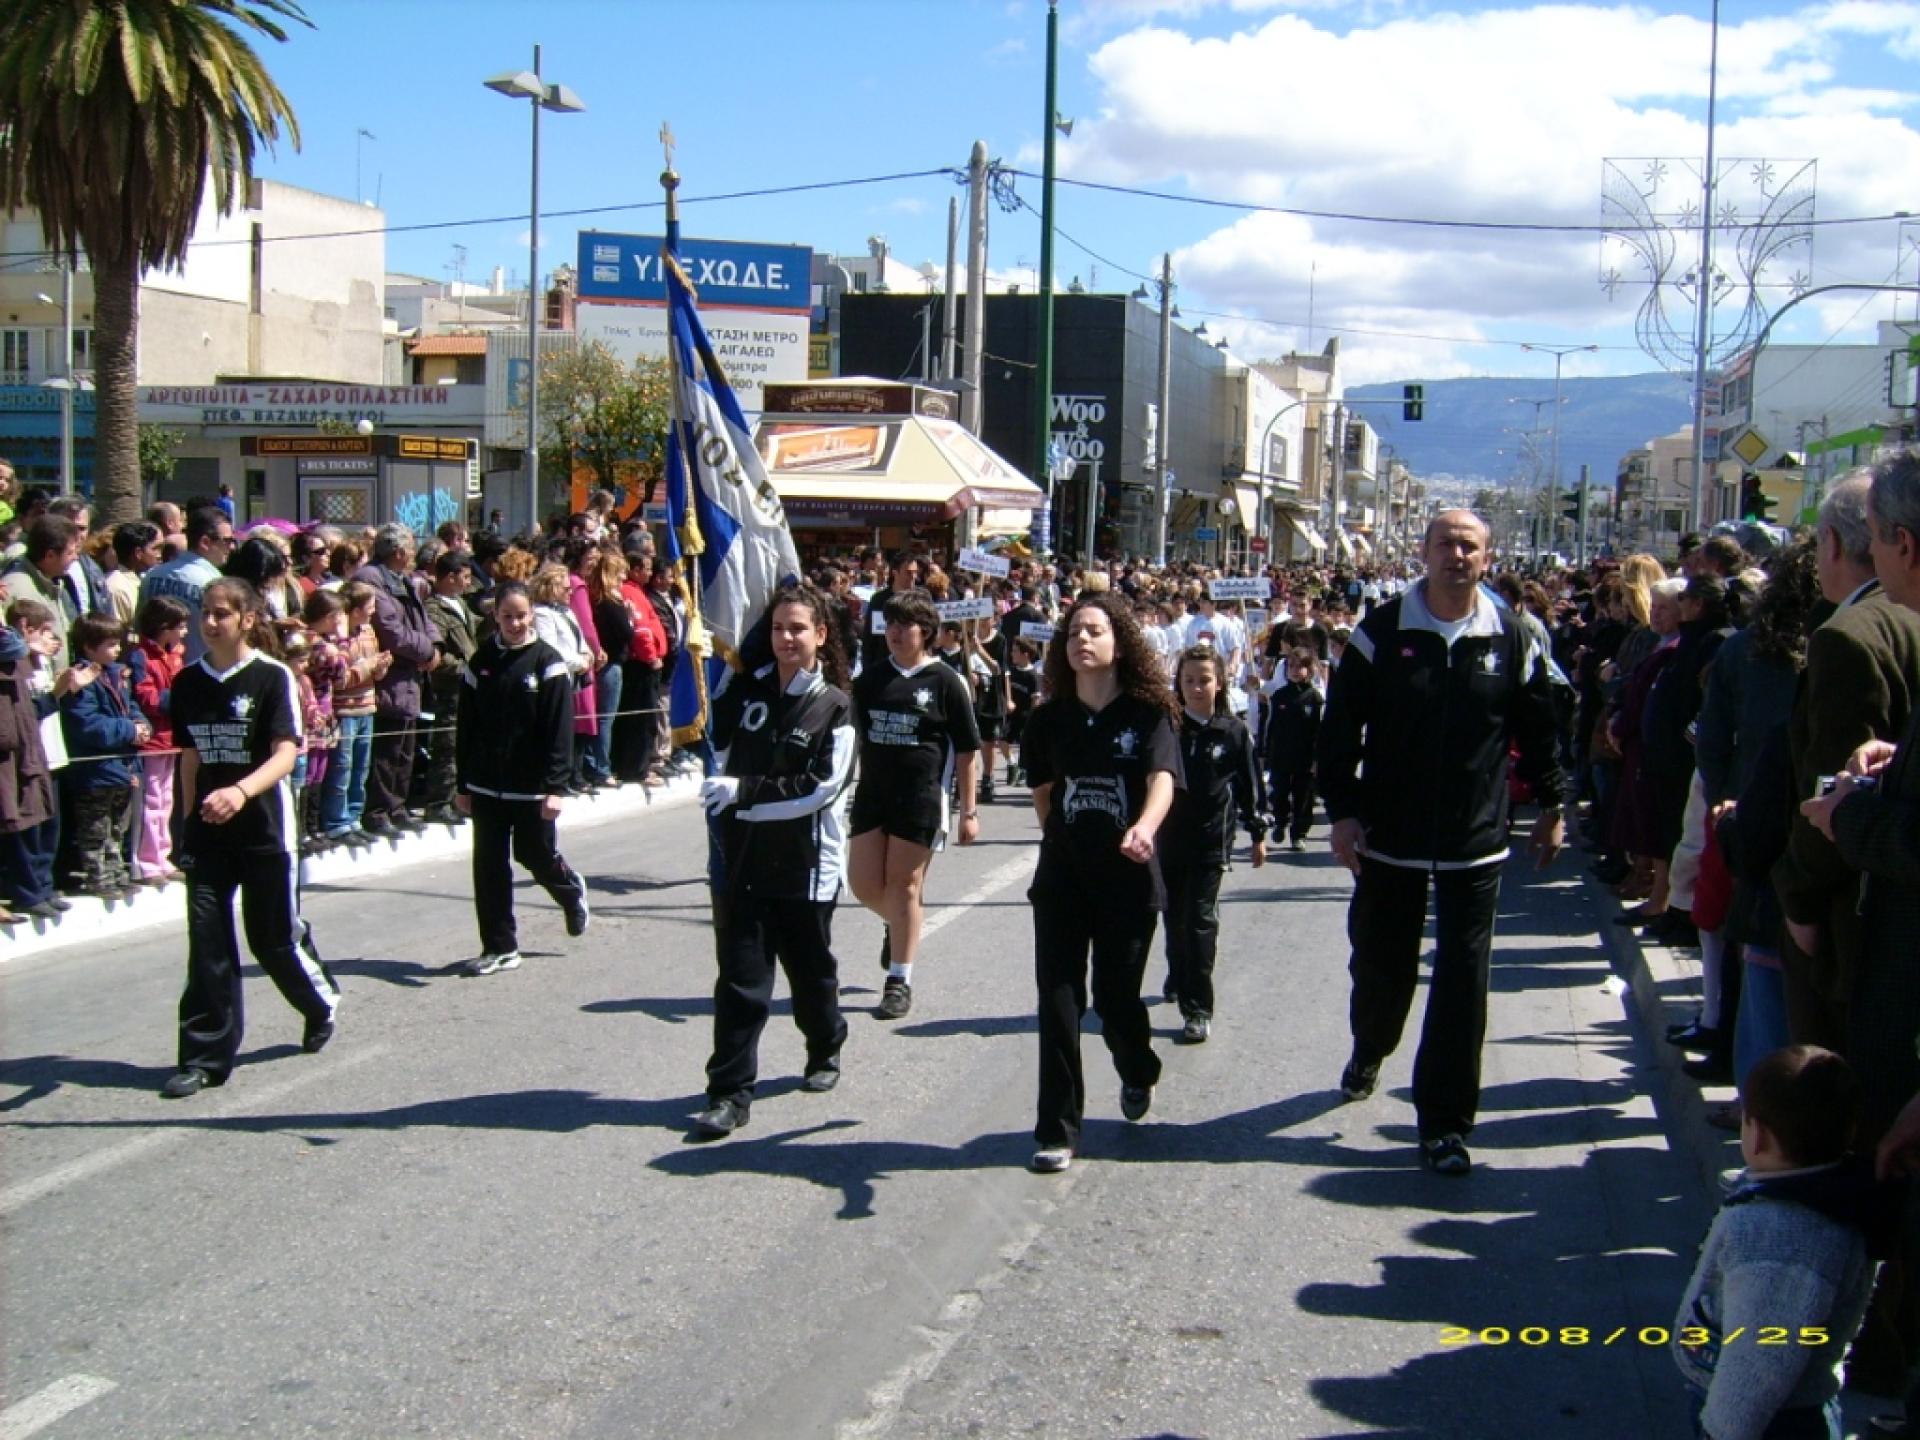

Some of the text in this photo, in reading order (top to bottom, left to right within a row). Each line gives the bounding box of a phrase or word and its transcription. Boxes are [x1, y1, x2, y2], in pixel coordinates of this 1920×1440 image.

[706, 329, 799, 344] ΚΤΑΣΗ ΜΕΤΡΟ
[719, 344, 776, 358] ΑΙΓΑΛΕΩ
